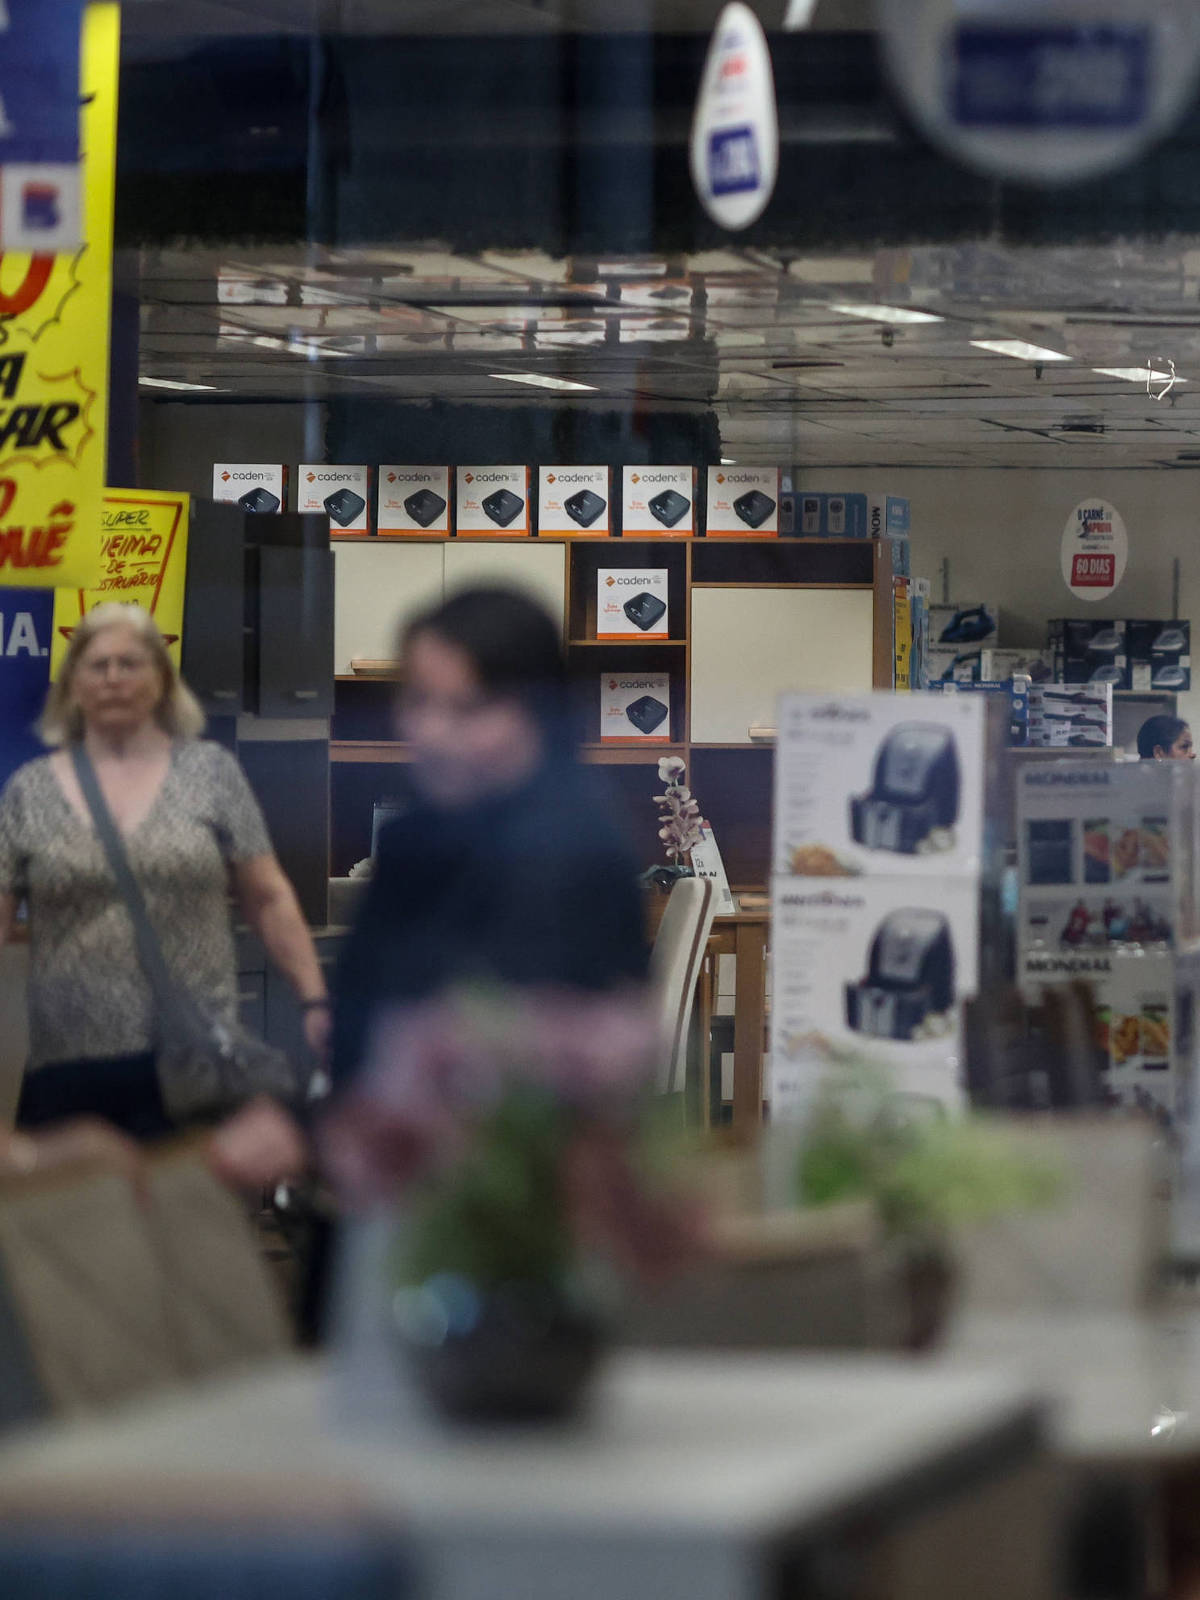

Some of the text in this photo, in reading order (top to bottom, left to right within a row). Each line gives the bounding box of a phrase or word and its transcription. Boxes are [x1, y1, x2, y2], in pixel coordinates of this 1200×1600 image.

[0, 402, 80, 451] AR
[1076, 558, 1111, 575] 60 DIAS
